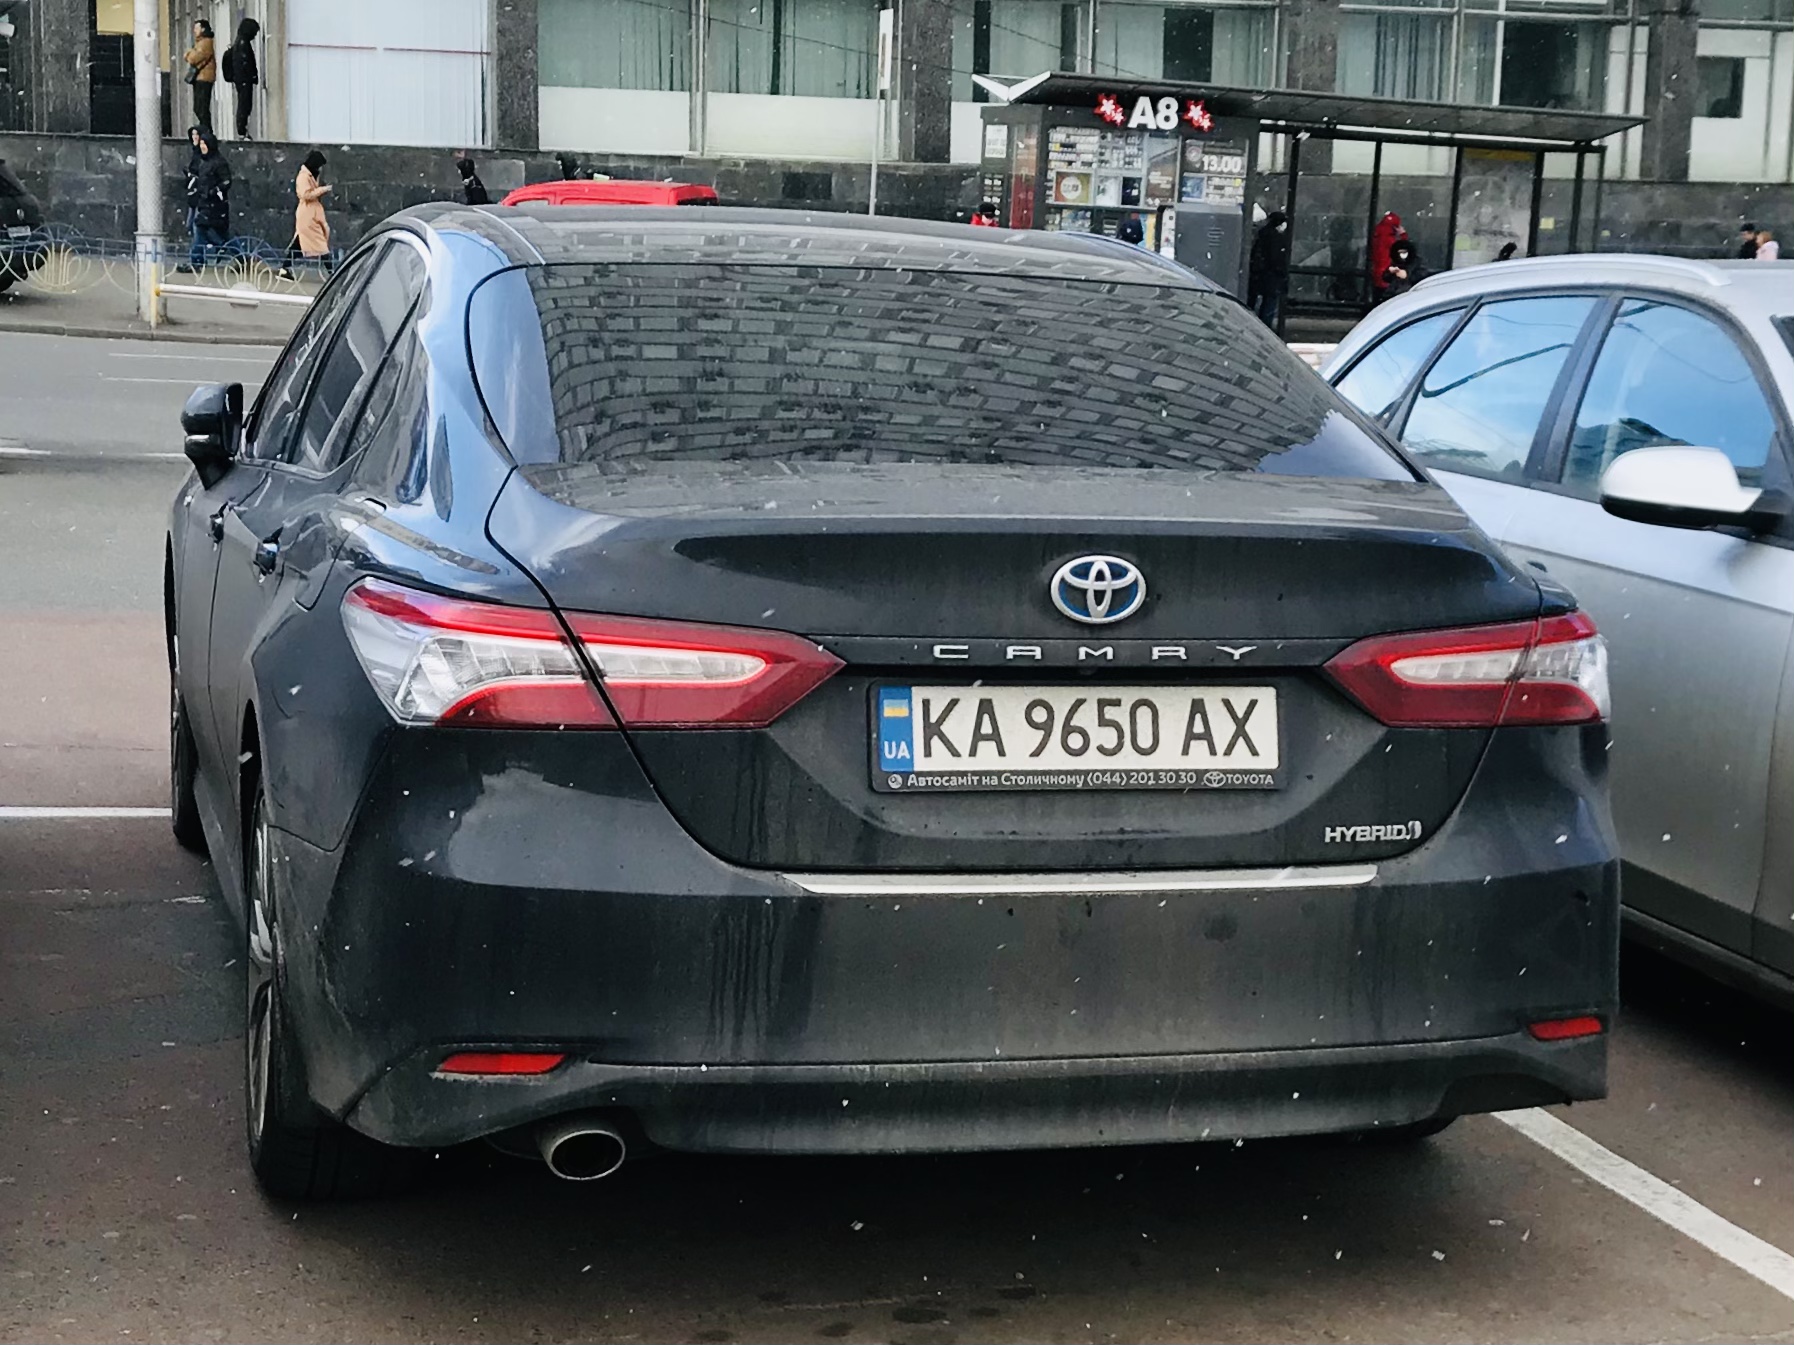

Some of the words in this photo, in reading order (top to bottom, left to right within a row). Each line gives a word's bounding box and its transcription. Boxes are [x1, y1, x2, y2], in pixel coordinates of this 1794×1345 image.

[1128, 96, 1179, 130] A8
[933, 644, 1257, 660] CAMRY
[922, 698, 1006, 757] KA
[1024, 698, 1159, 757] 9650
[1181, 698, 1260, 757] AX
[884, 741, 910, 760] UA
[907, 774, 979, 788] Автосаміт
[982, 776, 999, 786] на
[1001, 773, 1084, 788] Столичному
[1086, 771, 1127, 786] (044)
[1129, 772, 1156, 785] 201
[1158, 772, 1176, 785] 30
[1178, 772, 1197, 785] 30
[1225, 773, 1274, 785] TOYOTA
[1325, 825, 1407, 842] HYBRID
